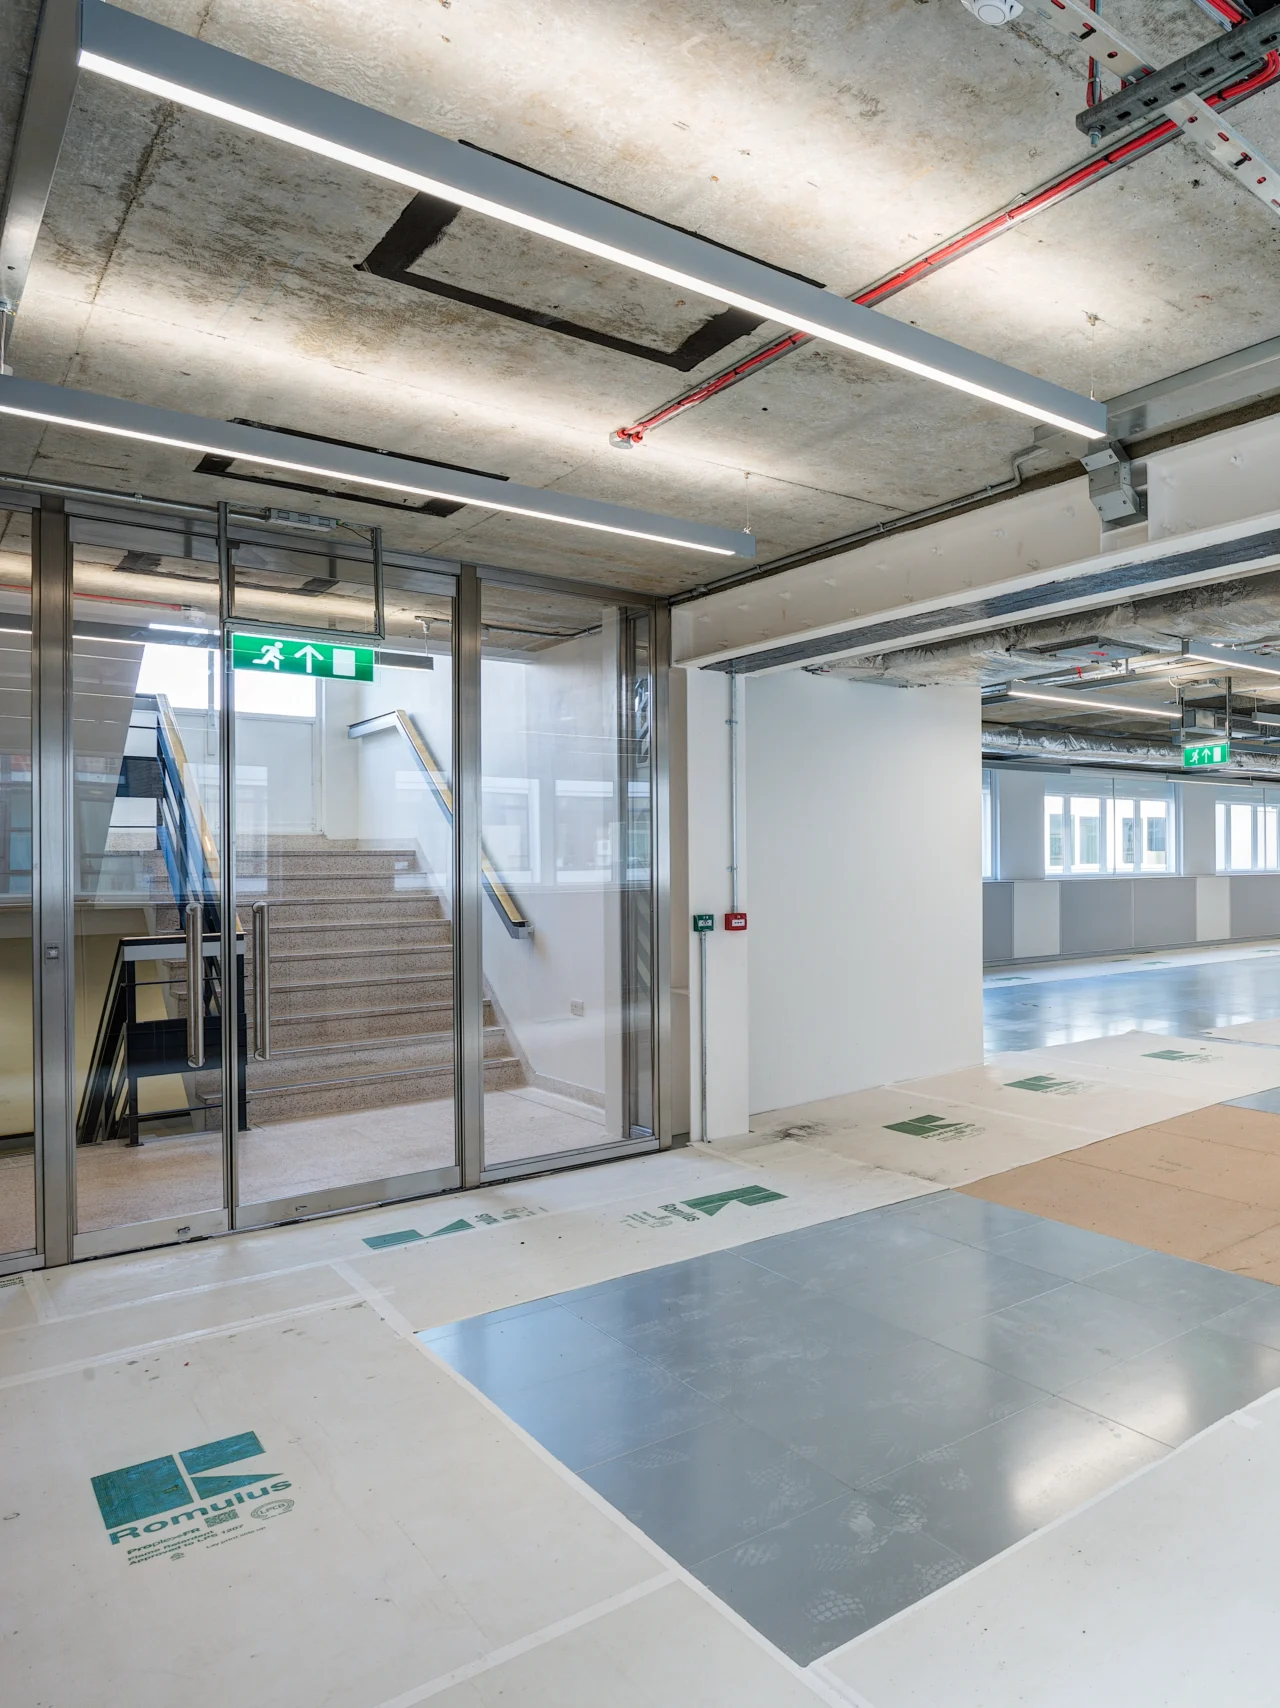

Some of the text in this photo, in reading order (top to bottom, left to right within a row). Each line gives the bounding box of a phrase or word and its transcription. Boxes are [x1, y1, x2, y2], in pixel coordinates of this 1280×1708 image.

[657, 1203, 700, 1222] Romulus
[109, 1480, 292, 1546] Romulus
[260, 1503, 286, 1515] LPCB
[128, 1545, 181, 1566] Approved
[197, 1533, 218, 1543] LPS
[220, 1523, 244, 1534] 1207
[128, 1530, 214, 1561] Flame Retardant
